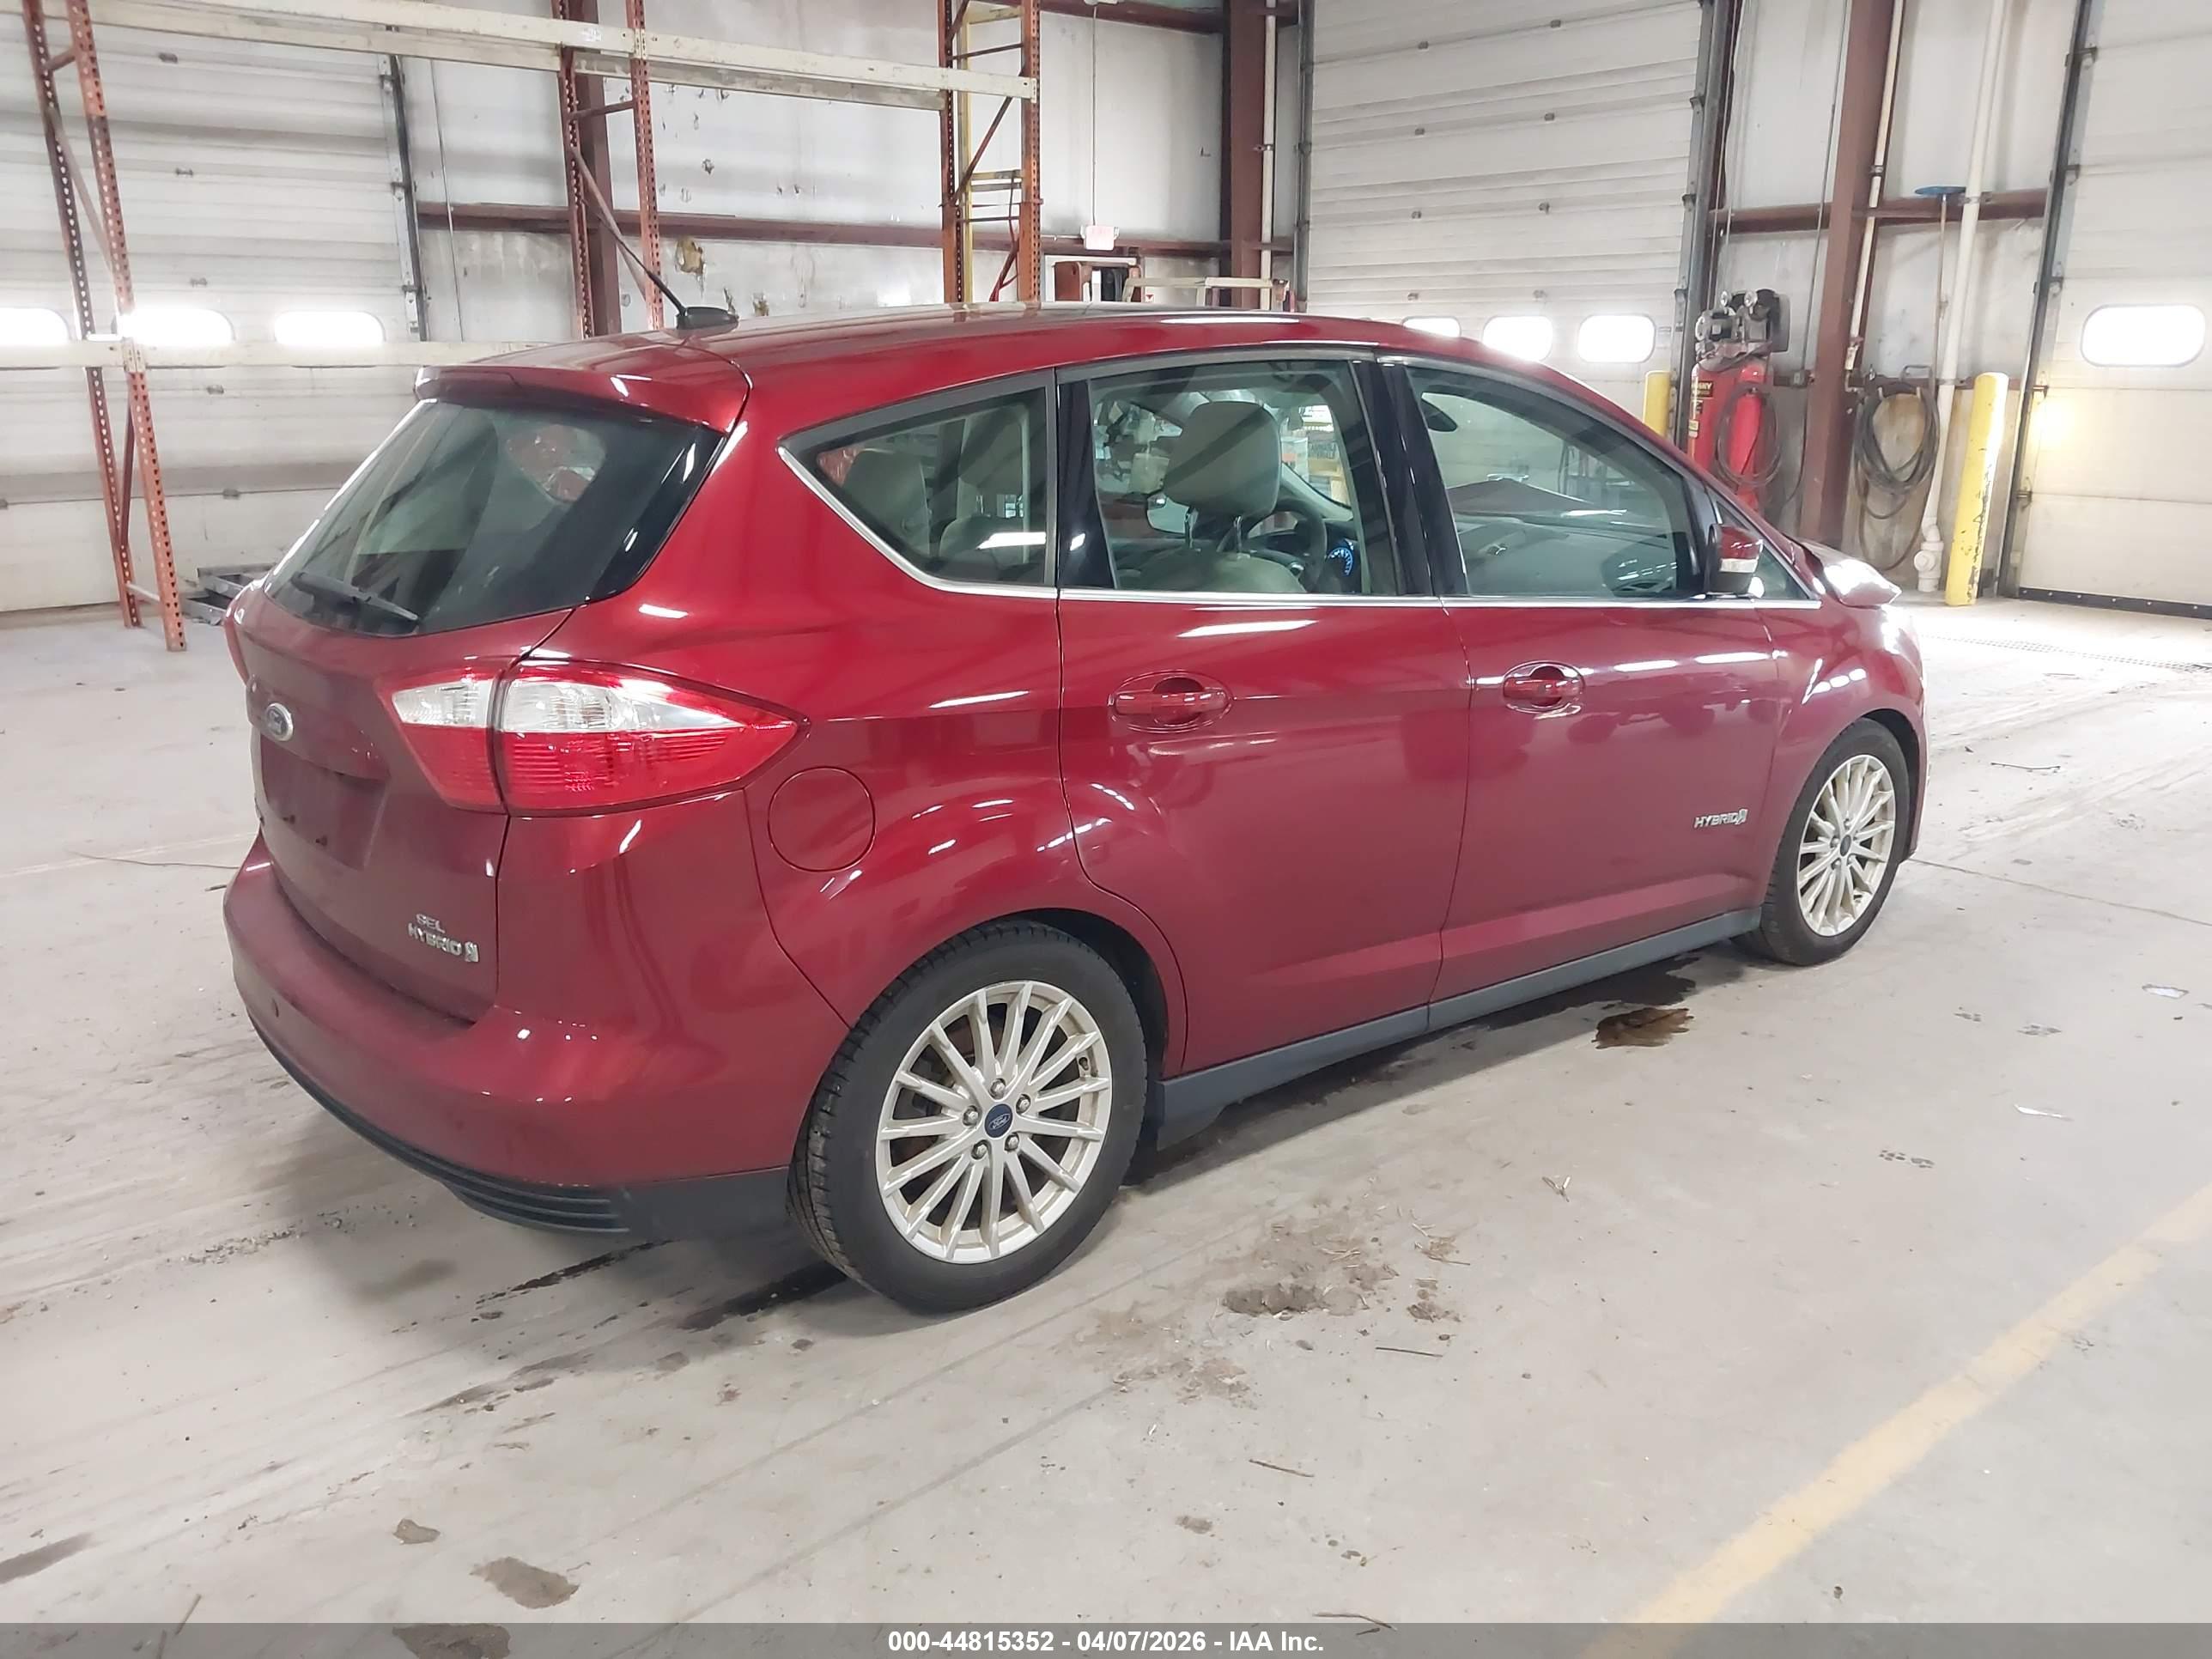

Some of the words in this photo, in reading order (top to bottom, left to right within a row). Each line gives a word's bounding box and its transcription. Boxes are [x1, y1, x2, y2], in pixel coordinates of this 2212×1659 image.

[1694, 811, 1739, 829] HYBRID
[416, 913, 446, 933] SEL
[407, 922, 462, 956] HYBRID
